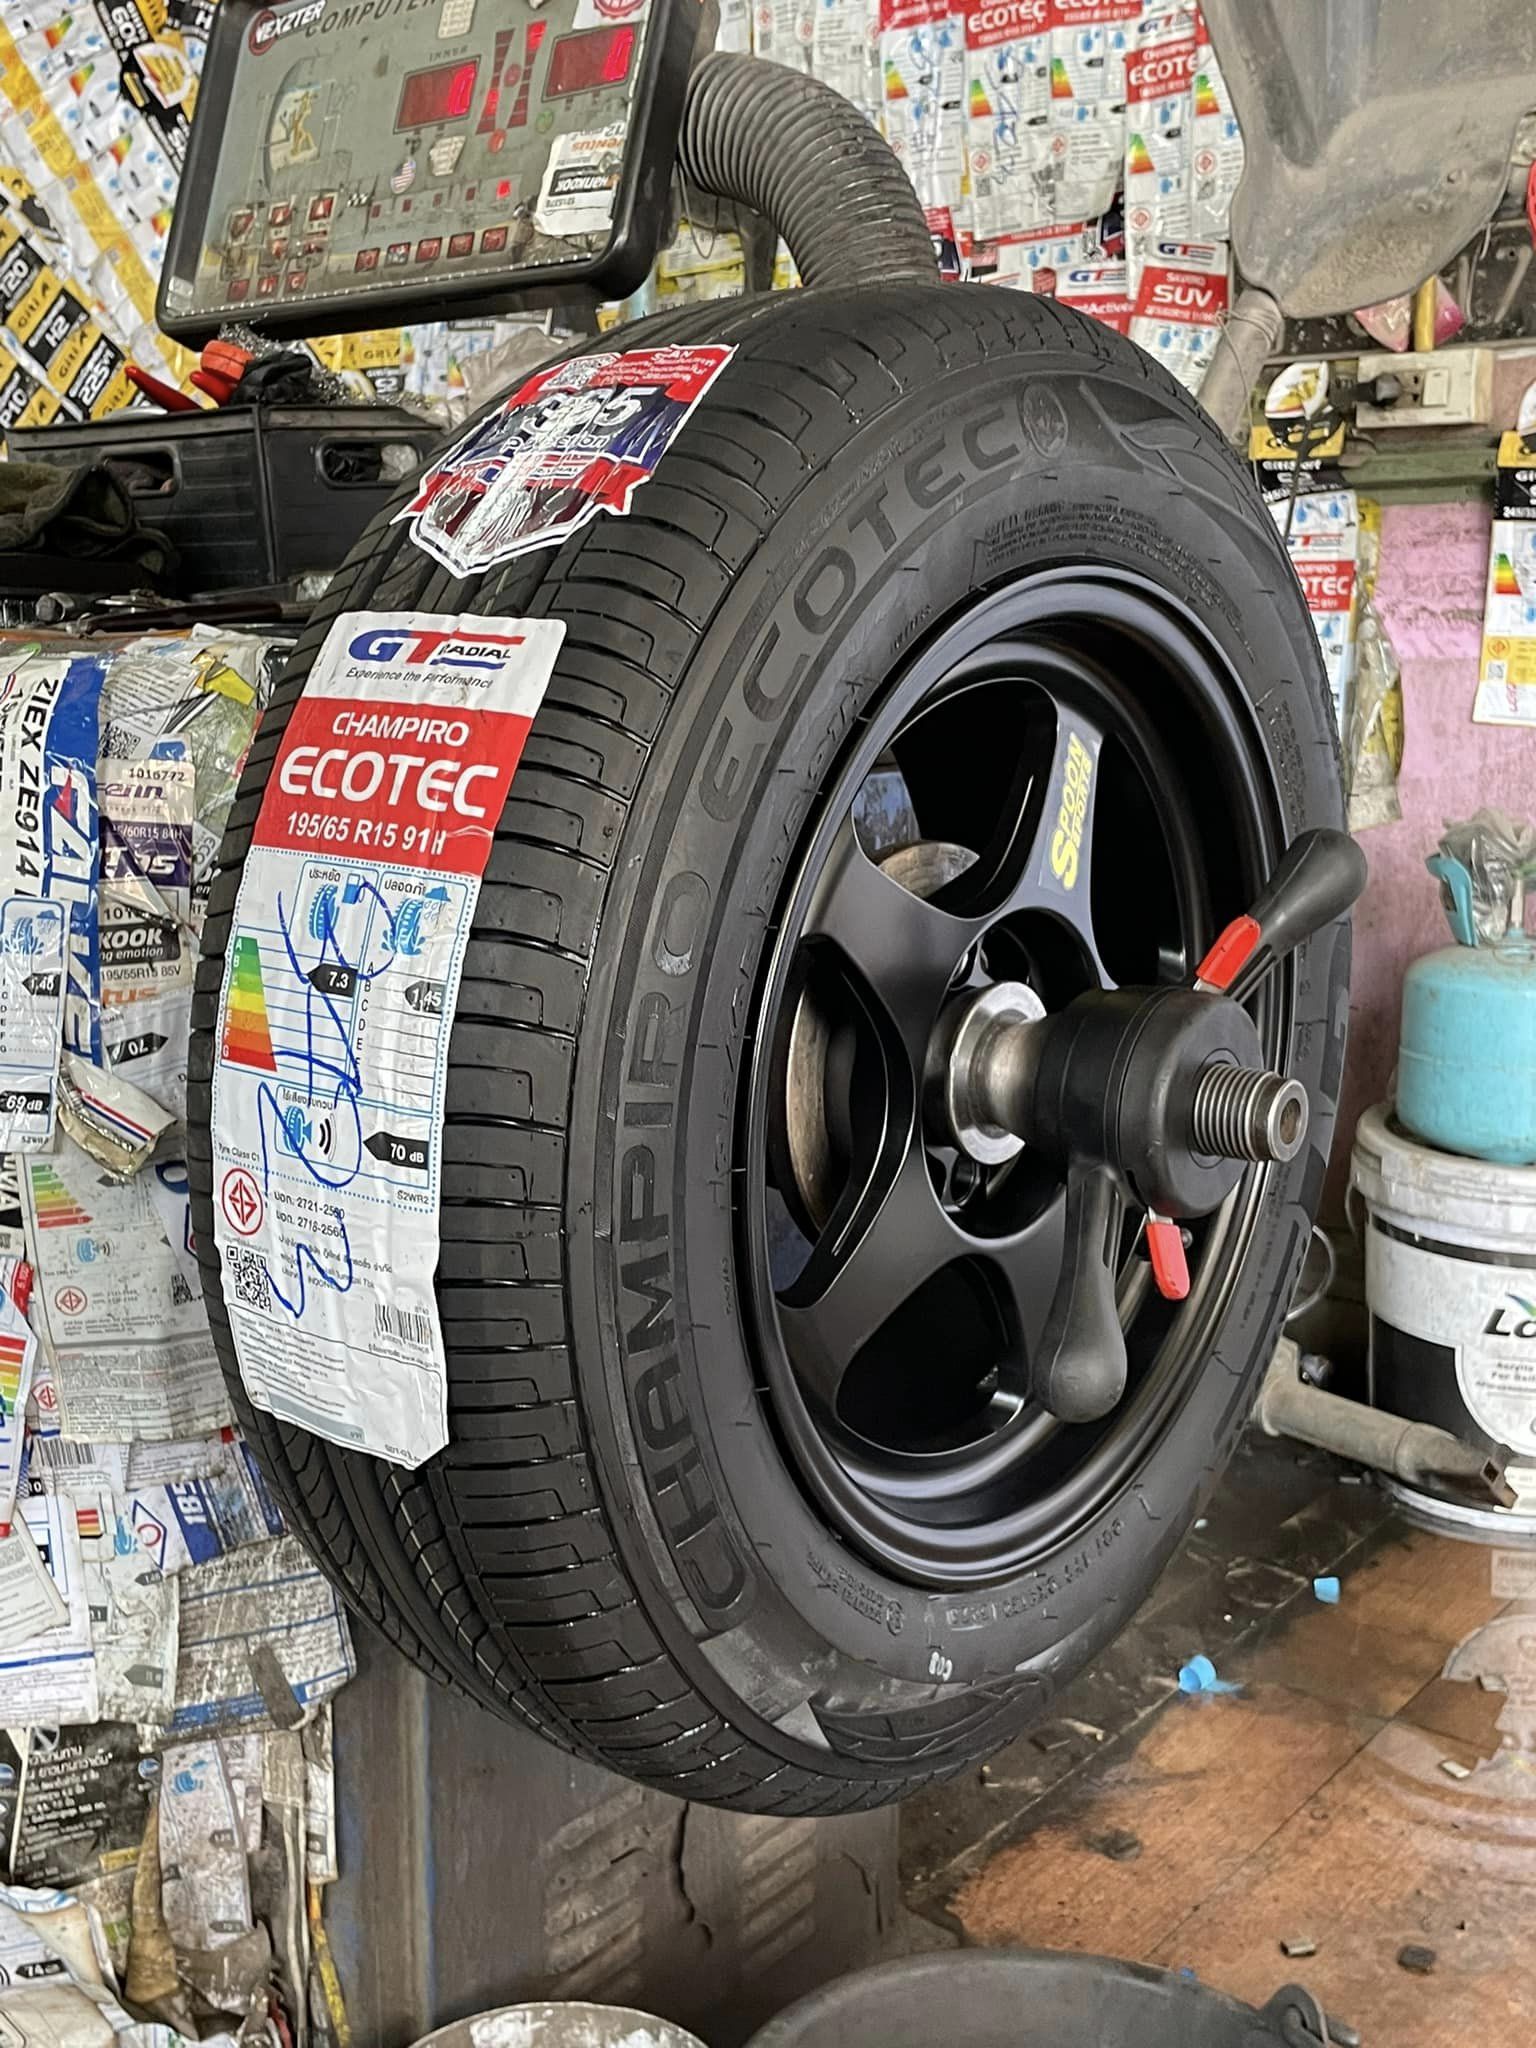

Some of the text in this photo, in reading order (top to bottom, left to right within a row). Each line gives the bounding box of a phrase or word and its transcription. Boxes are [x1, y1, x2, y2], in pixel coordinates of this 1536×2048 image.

[968, 2, 1047, 32] ECOTEC
[1151, 284, 1213, 308] SUV
[44, 315, 71, 347] H2
[701, 408, 1020, 822] ECOTEC
[436, 643, 512, 660] RADIAL
[345, 667, 402, 682] Experience
[402, 669, 421, 683] the
[332, 711, 470, 747] CHAMPIRO
[13, 677, 60, 879] ZIEX ZE914
[279, 746, 499, 819] ECOTEC
[1052, 731, 1084, 891] SPOON
[286, 810, 448, 856] 195/65 R15 91H
[384, 877, 426, 896] ปลอดภั
[115, 947, 165, 961] emotion
[328, 971, 349, 989] 7.3
[390, 1143, 425, 1164] 70 dB
[396, 1190, 430, 1206] S2WR2
[618, 871, 746, 1610] CHAMPIRO
